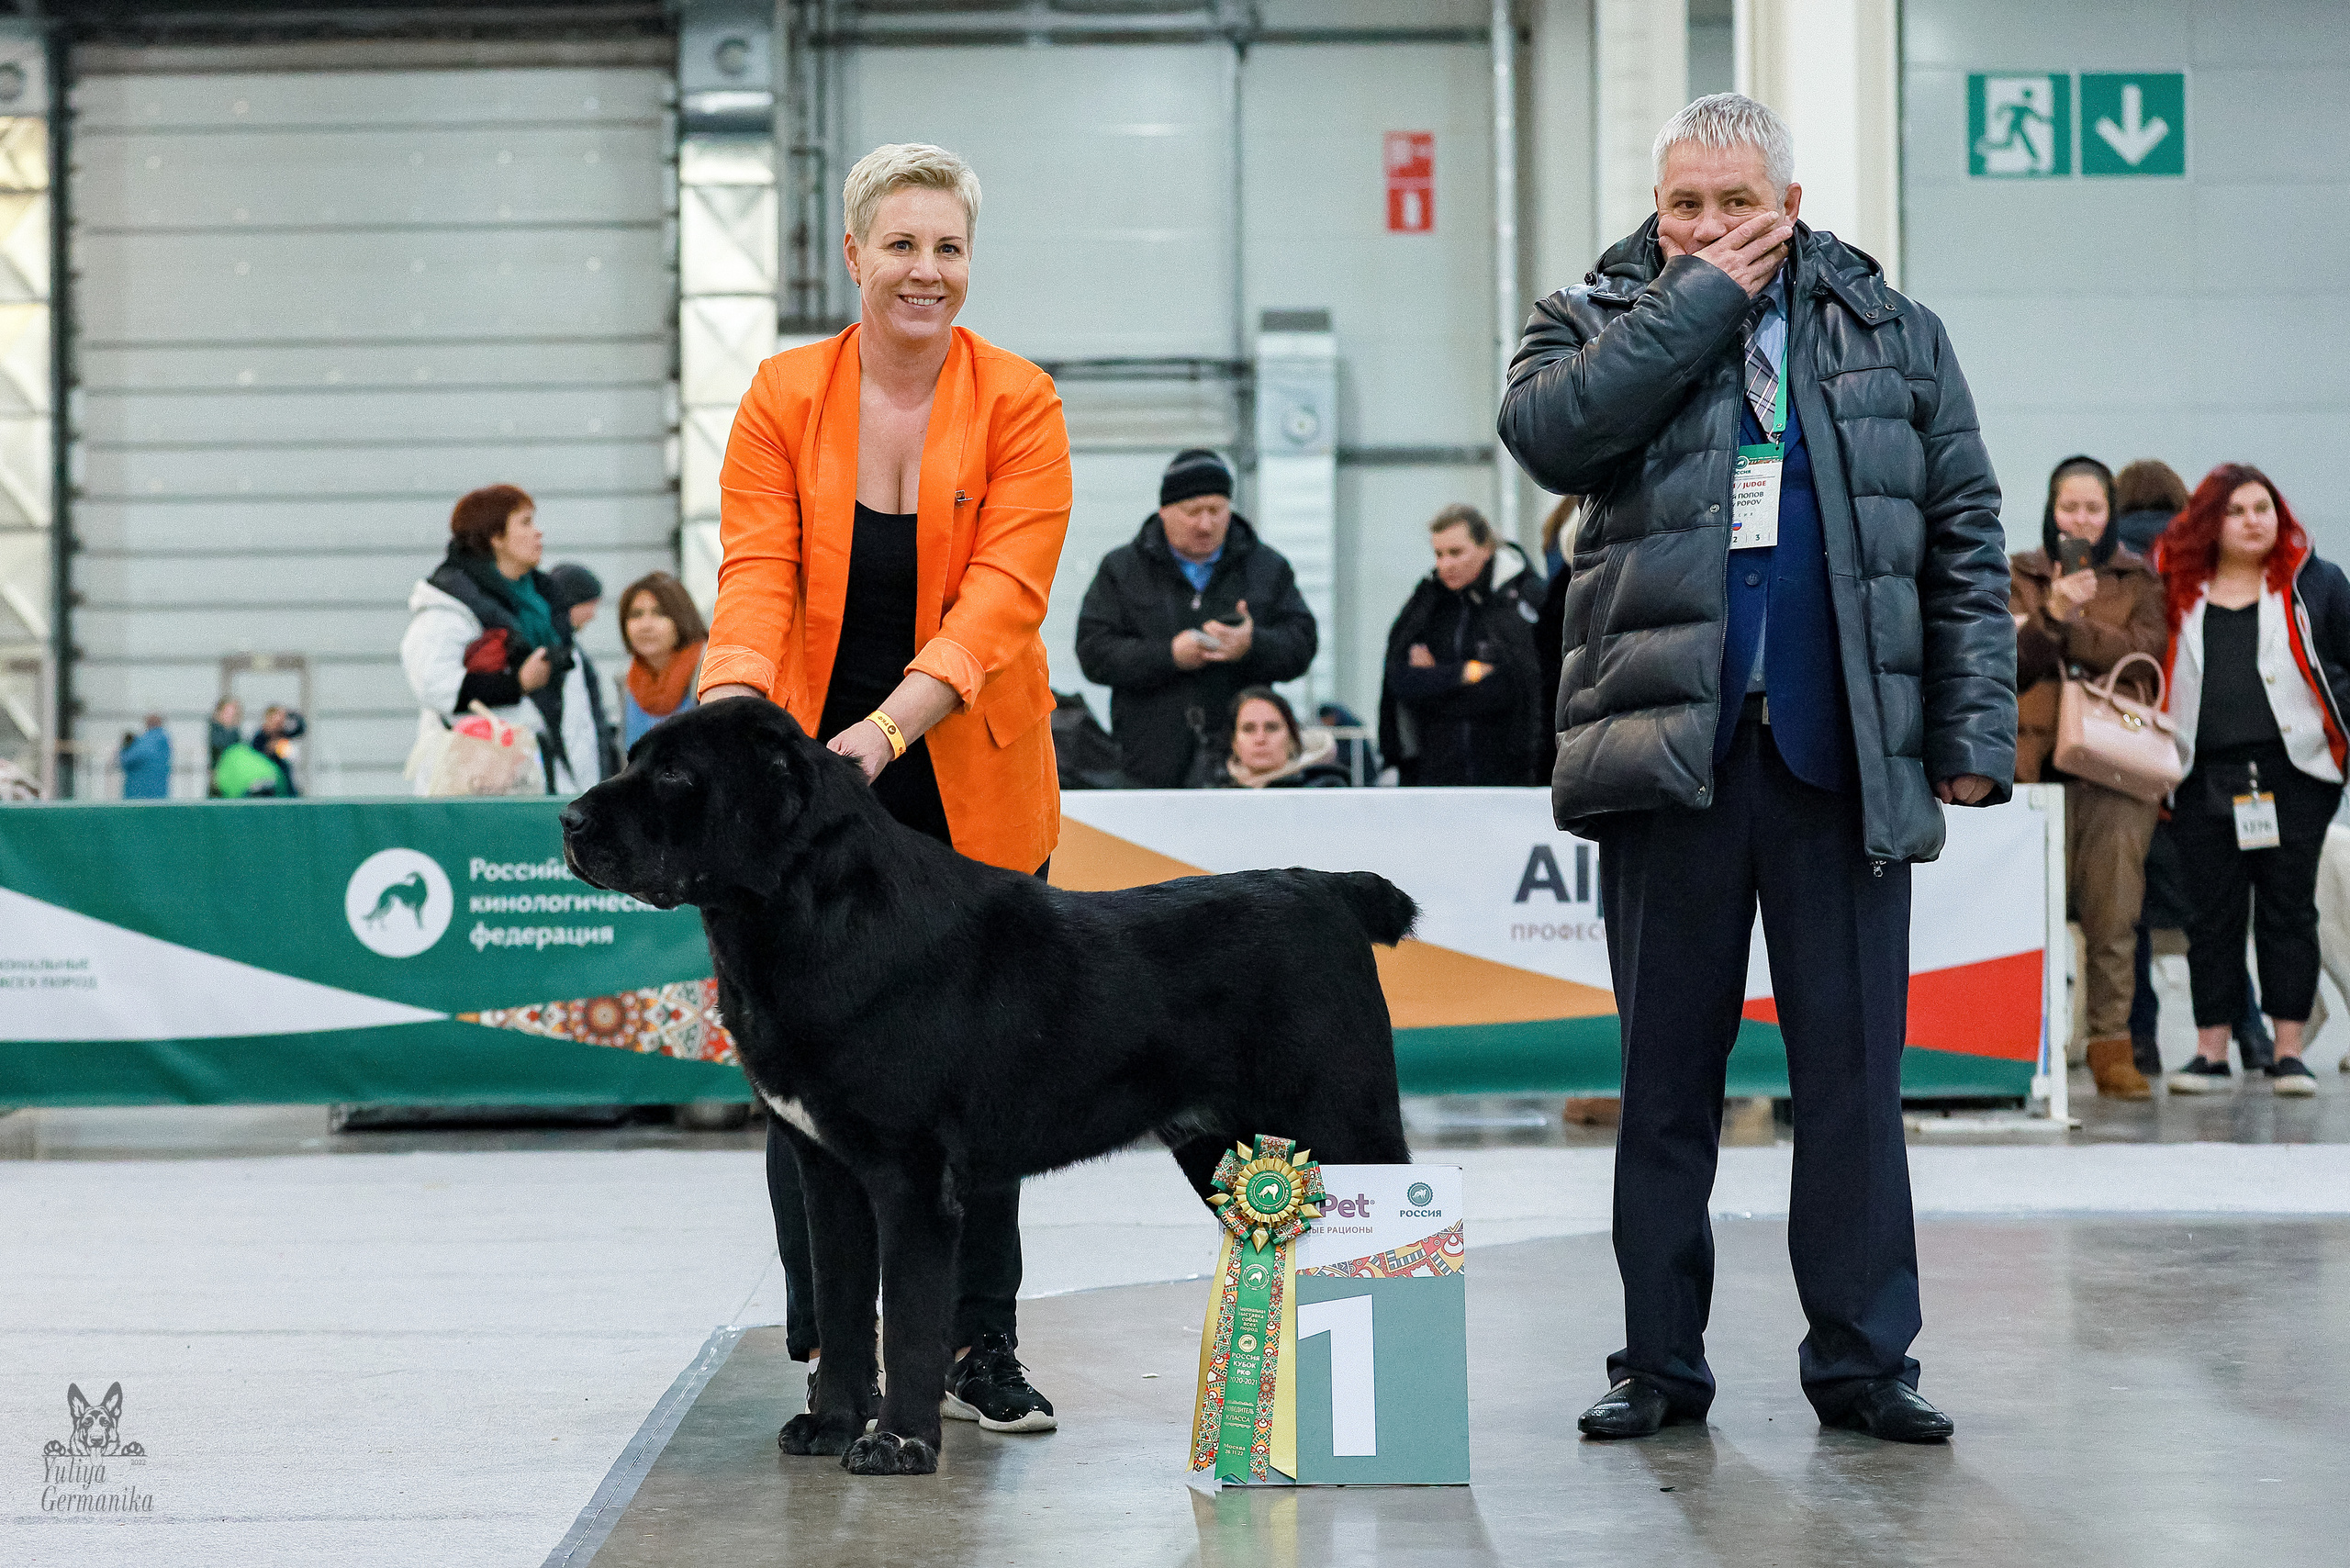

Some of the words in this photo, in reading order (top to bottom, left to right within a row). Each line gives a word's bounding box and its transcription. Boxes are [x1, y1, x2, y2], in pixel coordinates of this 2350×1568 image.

[1742, 480, 1767, 489] JUDGE
[468, 857, 576, 881] Российс
[468, 893, 677, 913] кинологичес
[468, 920, 615, 952] федерация
[1510, 924, 1606, 941] ПРОФЕС
[1399, 1209, 1442, 1218] РОССИЯ
[1326, 1226, 1373, 1235] РАЦИОНЫ
[1231, 1351, 1260, 1361] РОССИЯ
[1233, 1361, 1257, 1370] КУБОК
[1297, 1294, 1377, 1457] 1
[1225, 1406, 1254, 1415] ПОБЕДИТЕЛЬ
[1225, 1414, 1251, 1423] КЛАССА
